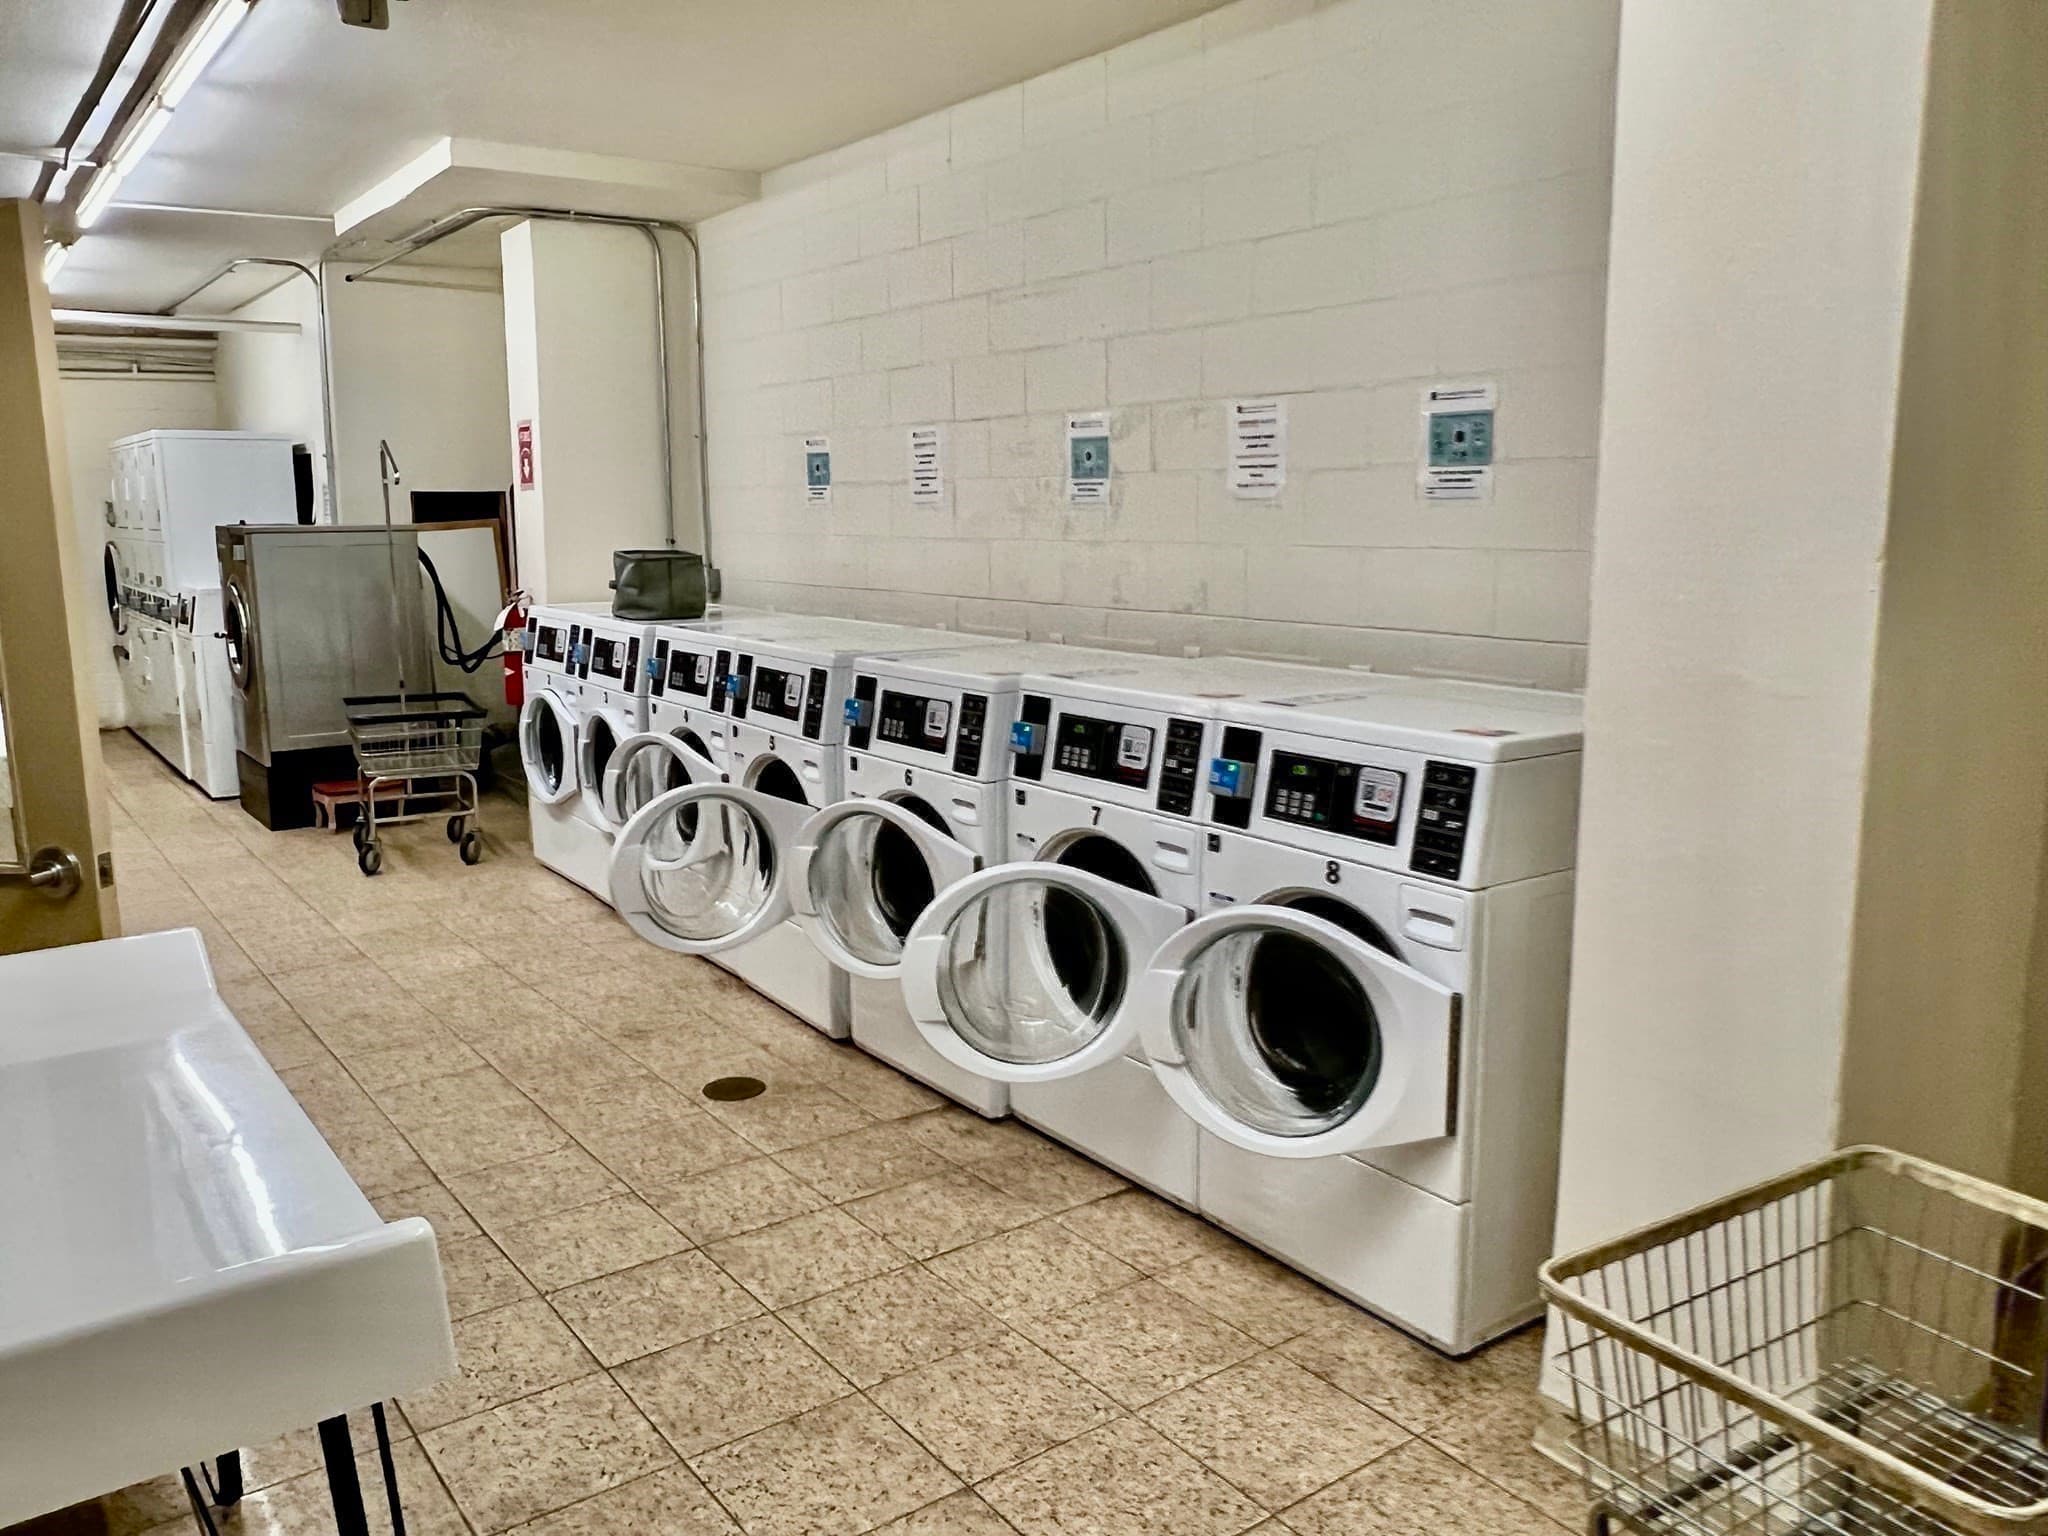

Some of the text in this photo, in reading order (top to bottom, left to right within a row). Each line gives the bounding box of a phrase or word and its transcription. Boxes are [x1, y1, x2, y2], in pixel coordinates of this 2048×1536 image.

[904, 768, 912, 786] 6
[1091, 806, 1101, 825] 7
[1326, 860, 1340, 884] 8
